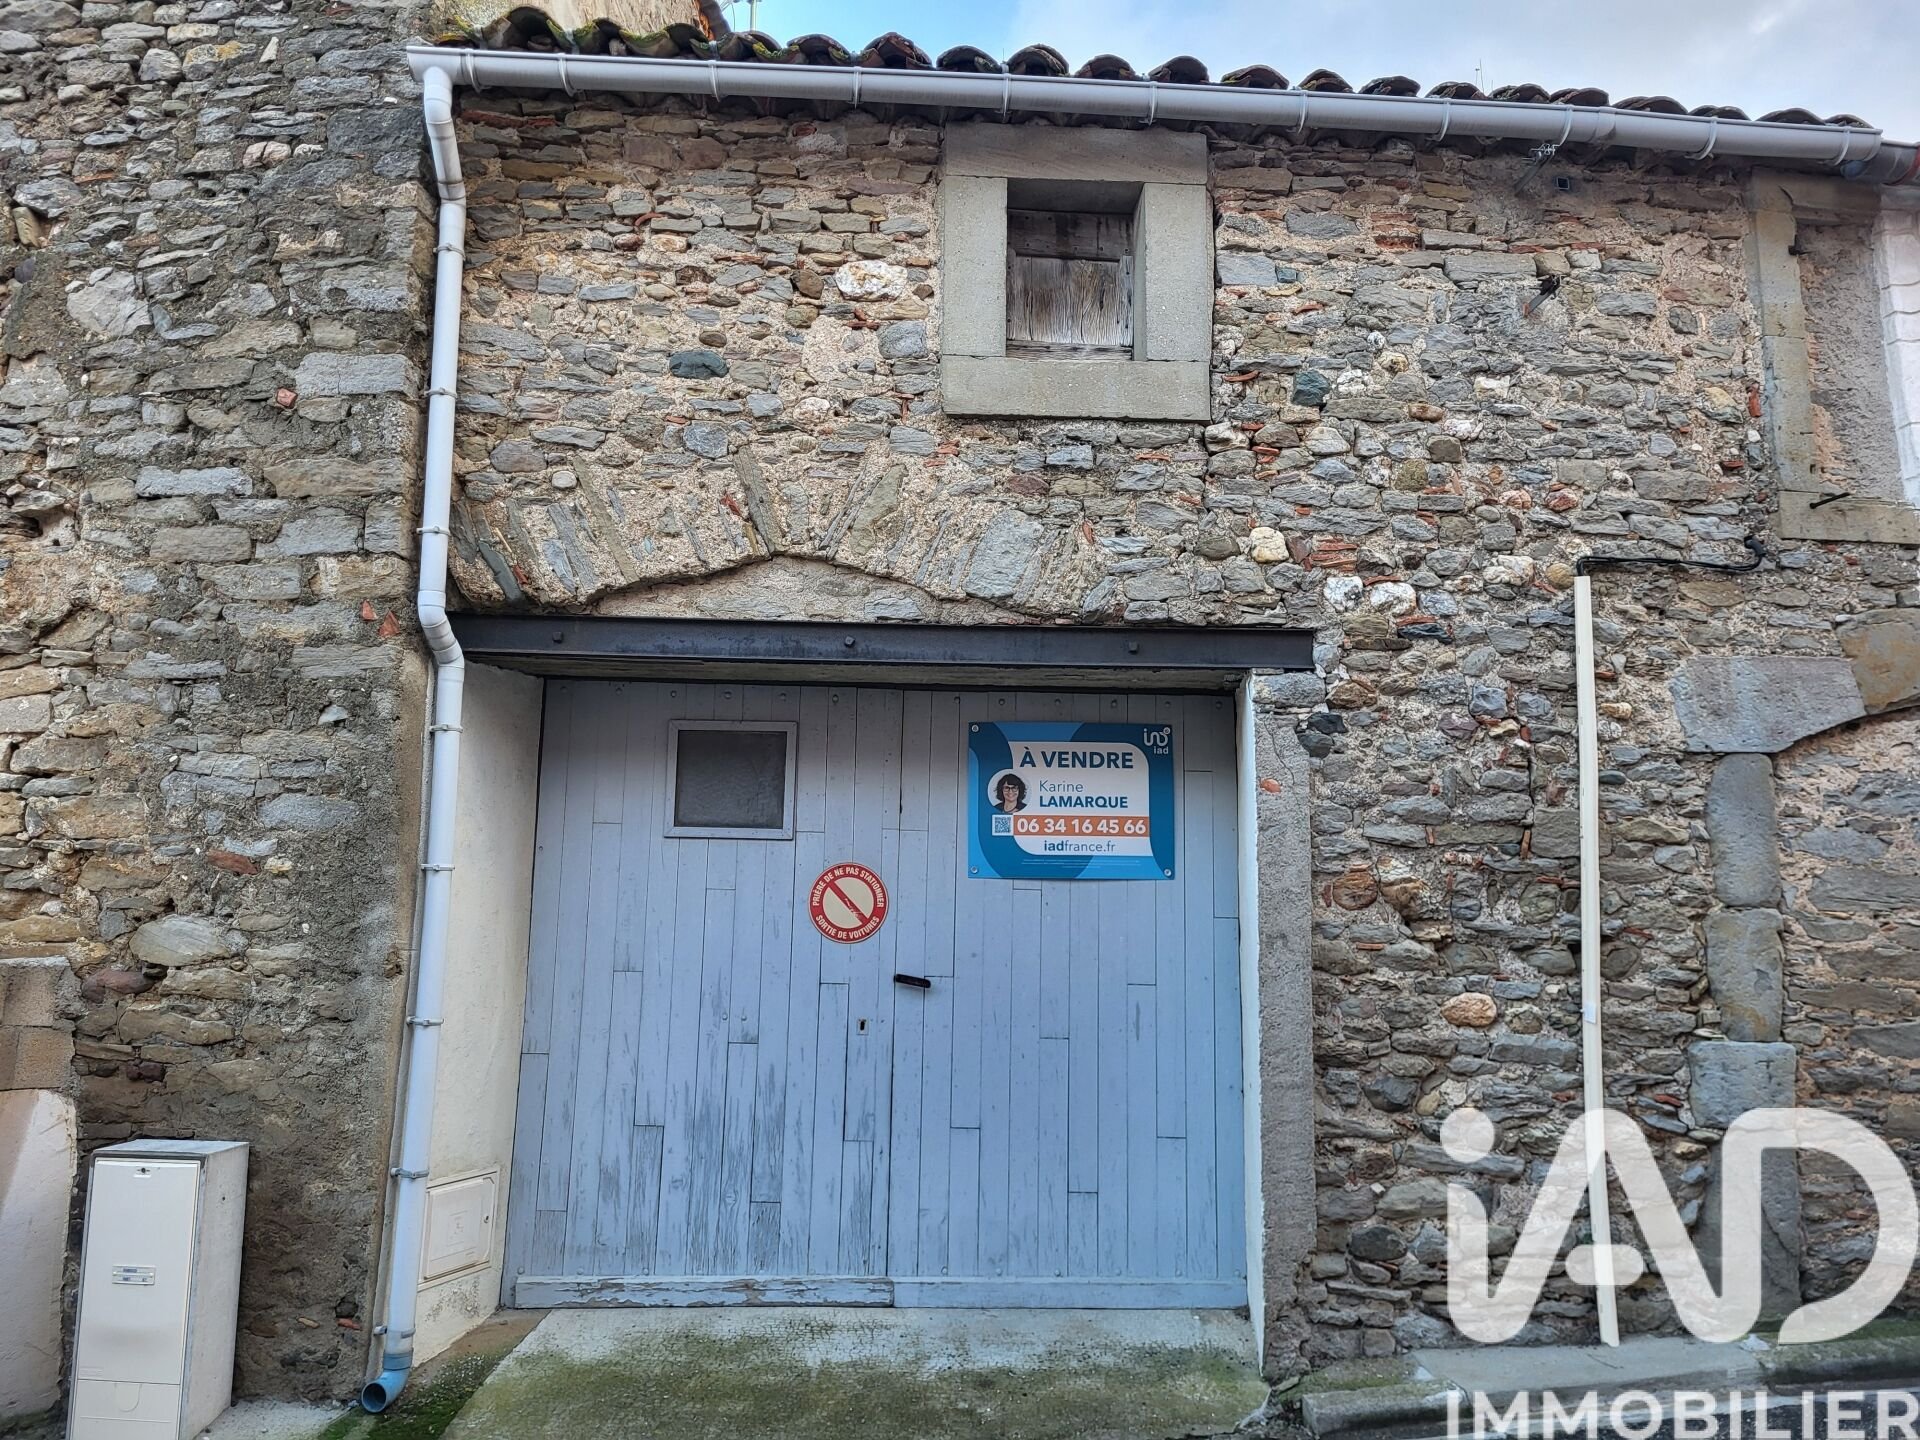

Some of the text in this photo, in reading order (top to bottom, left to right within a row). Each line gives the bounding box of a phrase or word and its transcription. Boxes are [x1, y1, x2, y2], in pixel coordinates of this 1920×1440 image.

[1019, 746, 1134, 769] À VENDRE
[1153, 745, 1169, 755] iad
[1039, 779, 1084, 793] Karine
[1039, 795, 1129, 809] LAMARQUE
[1017, 818, 1147, 835] 06 34 16 45 66
[1043, 839, 1117, 853] iadfrance.fr
[812, 866, 885, 907] PRIÈRE DE NE PAS STATIONNER
[816, 914, 880, 939] SORTIE DE VOITURES
